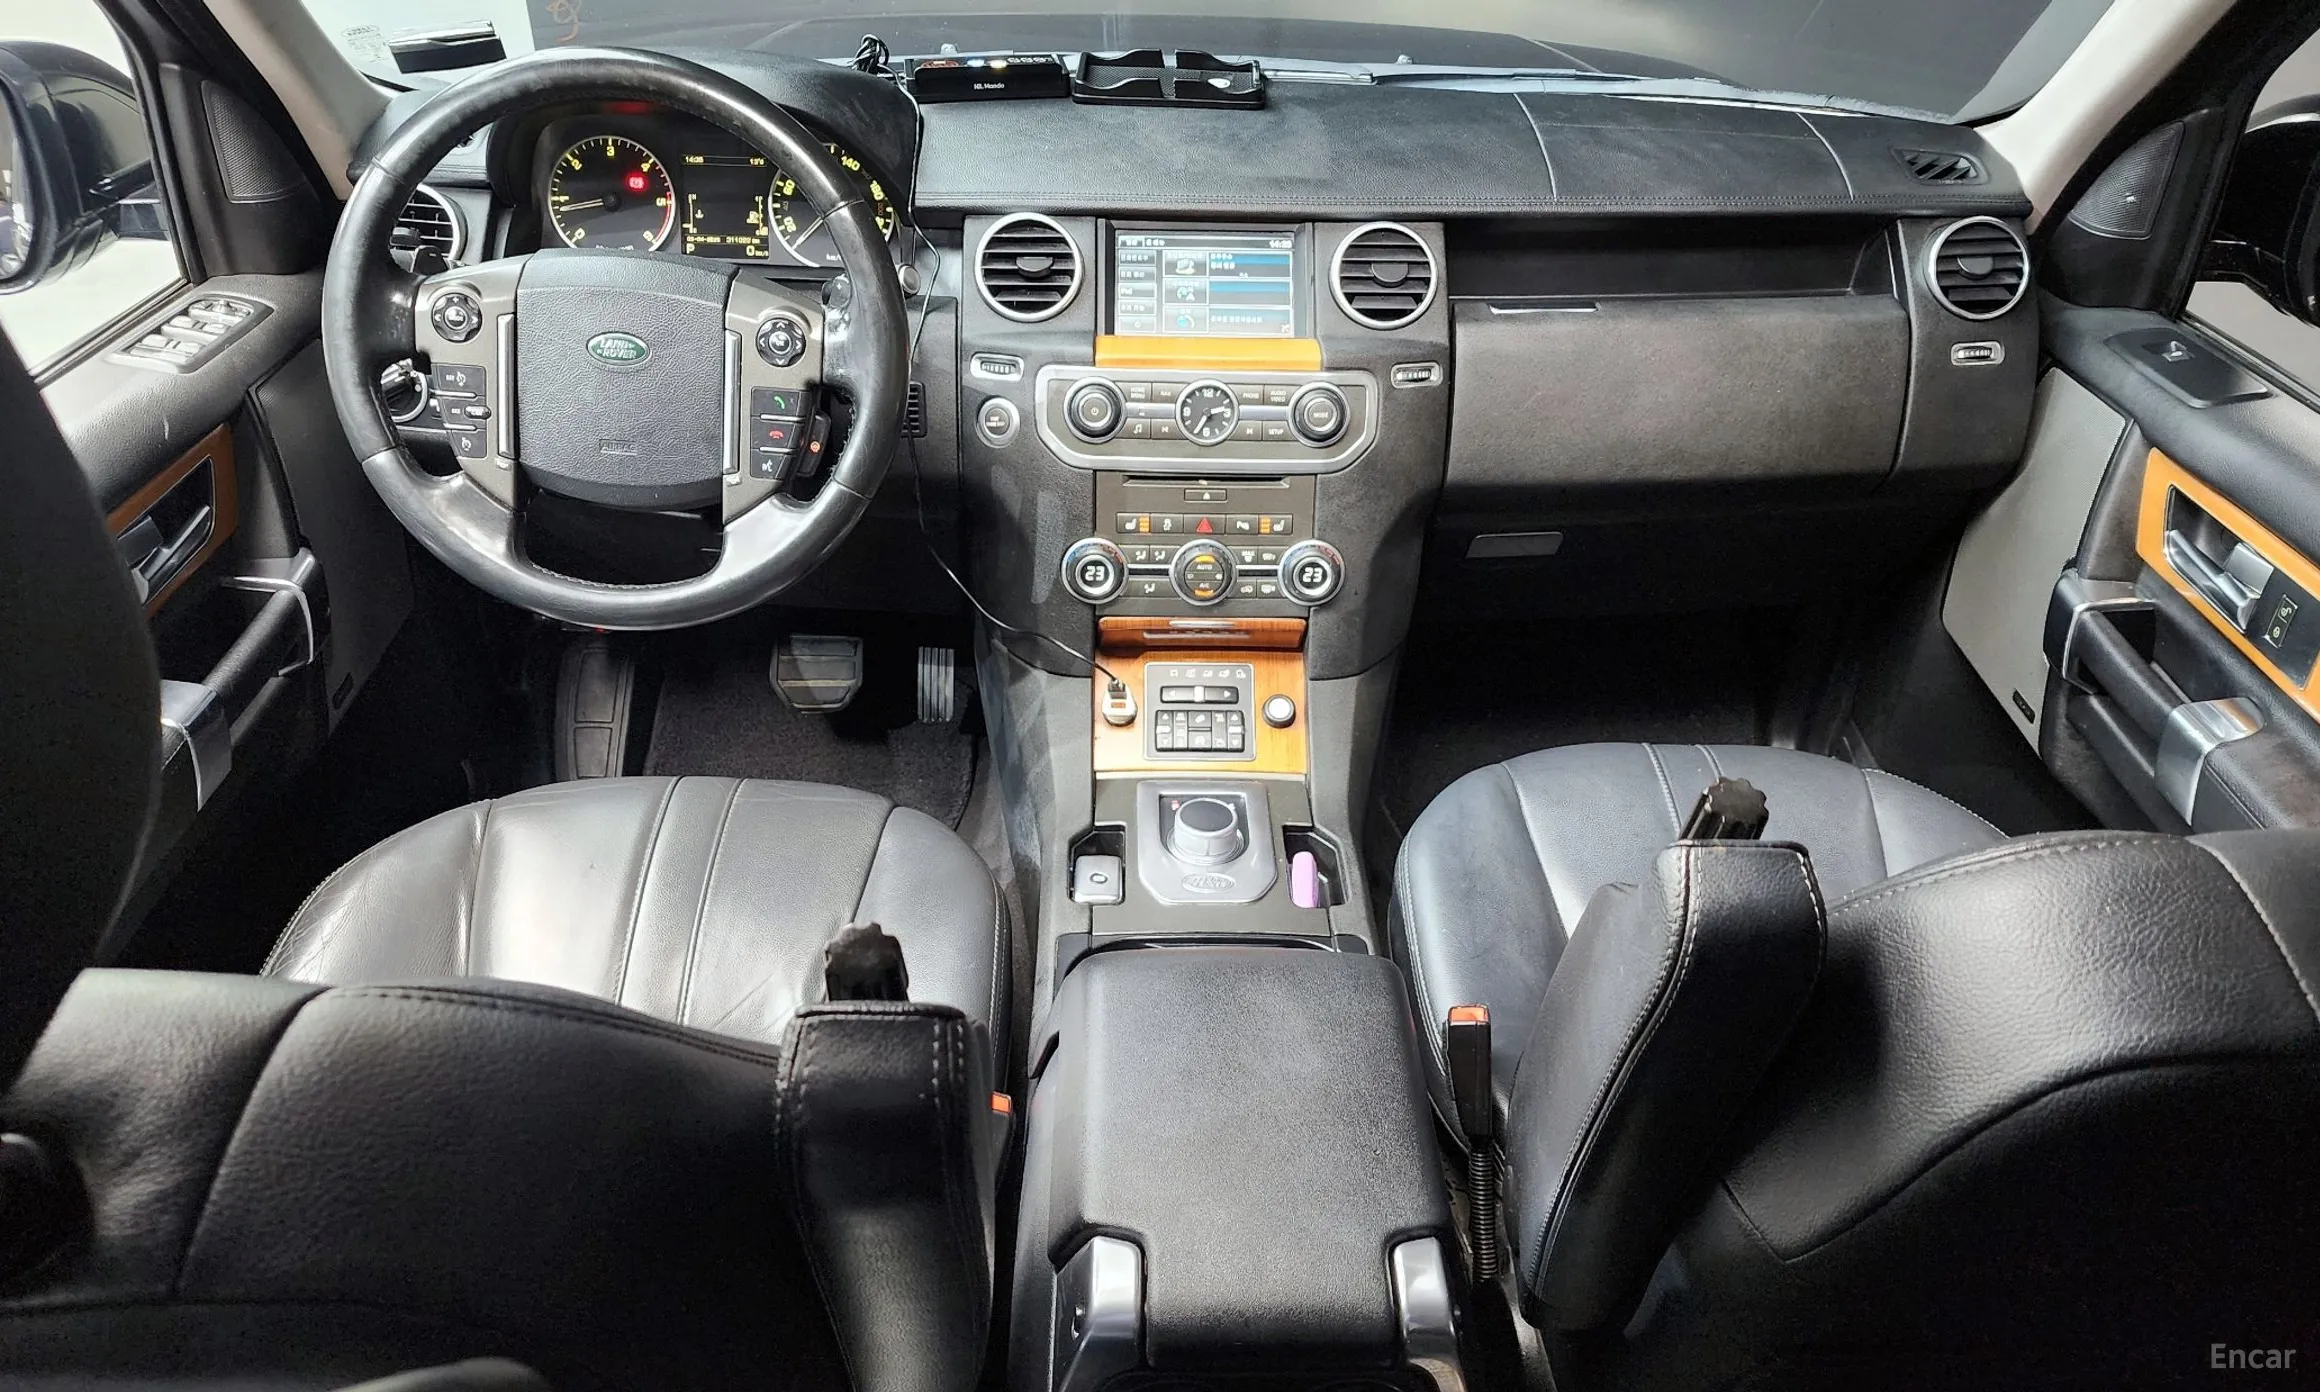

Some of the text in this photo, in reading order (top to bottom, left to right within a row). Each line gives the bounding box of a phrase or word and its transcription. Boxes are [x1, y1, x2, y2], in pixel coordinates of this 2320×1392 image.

[606, 146, 615, 157] 3
[571, 159, 582, 171] 2
[641, 163, 651, 172] 4
[841, 155, 860, 171] 140
[783, 179, 795, 195] 60
[869, 180, 885, 200] 180
[656, 197, 667, 206] 5
[783, 216, 796, 232] 20
[574, 228, 586, 240] 0
[686, 243, 696, 254] P
[746, 245, 755, 256] 0
[600, 339, 628, 349] LAND
[602, 348, 637, 359] ROVER
[1202, 388, 1214, 398] 12
[1183, 407, 1191, 417] 9
[1223, 407, 1231, 417] 3
[1203, 427, 1211, 437] 6
[1085, 565, 1105, 582] 23
[1302, 567, 1323, 583] 23
